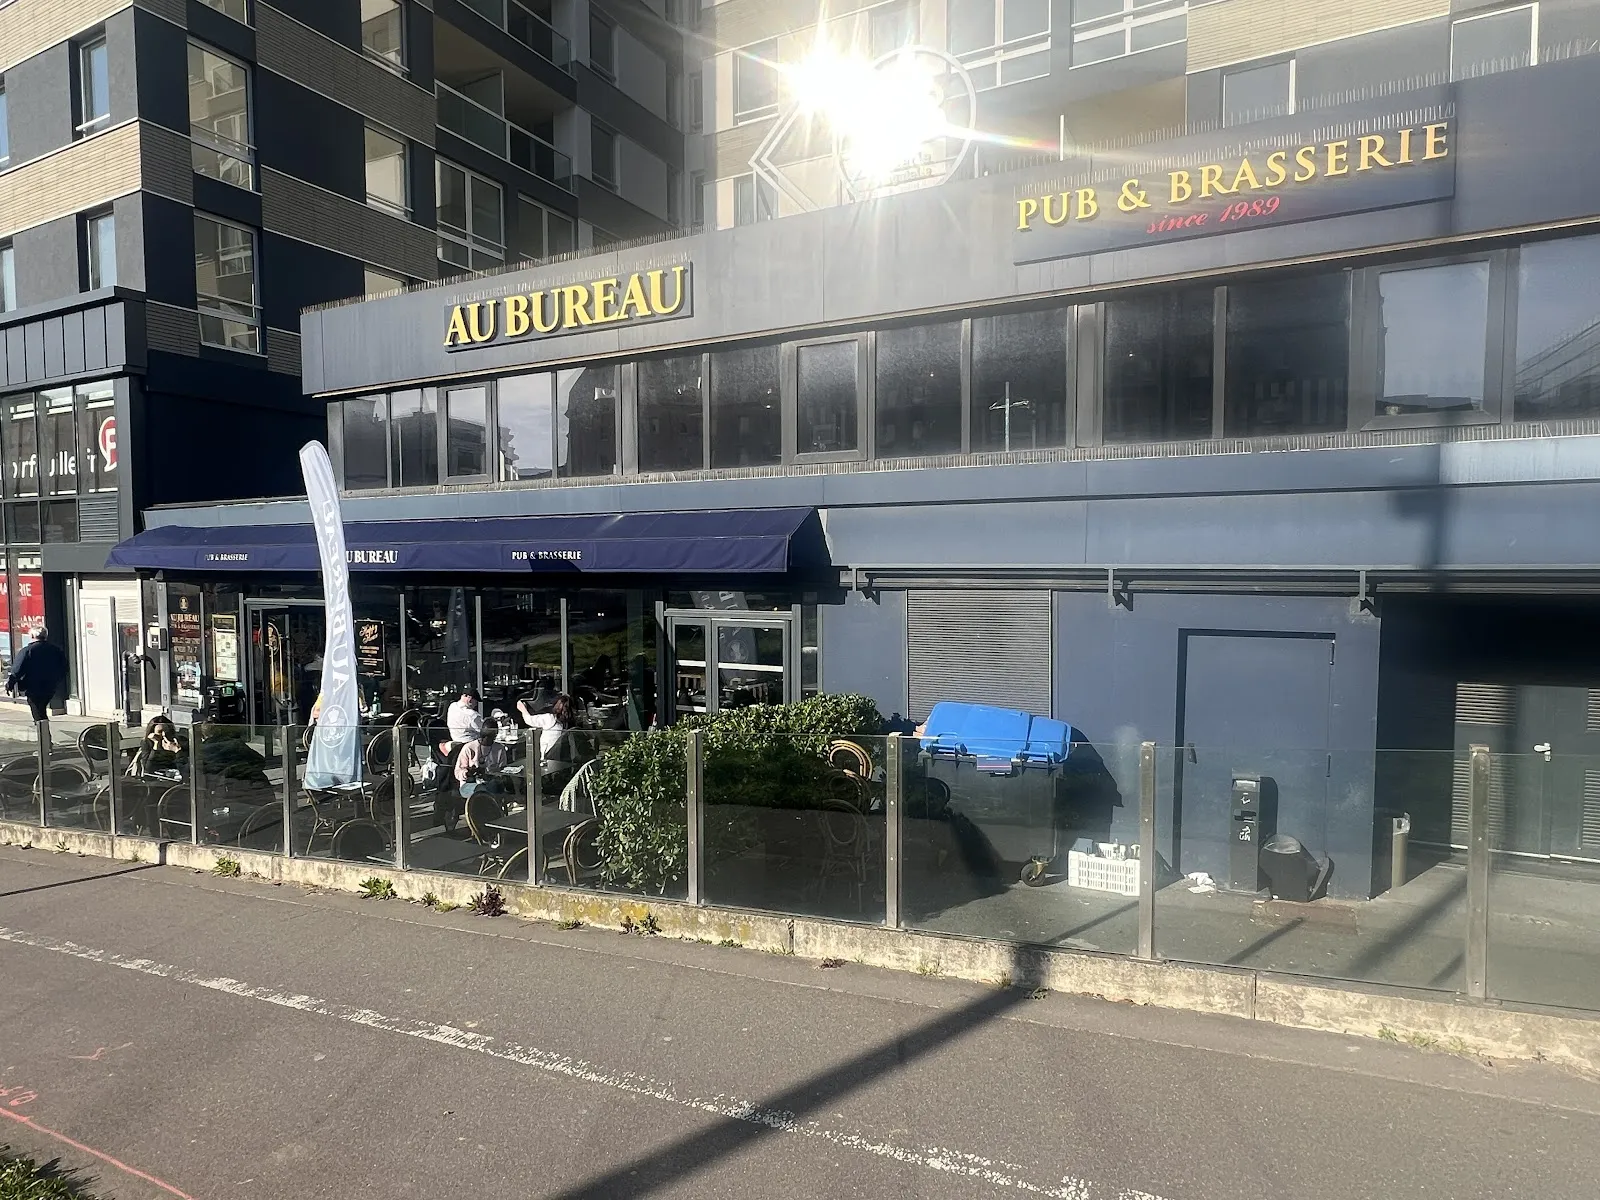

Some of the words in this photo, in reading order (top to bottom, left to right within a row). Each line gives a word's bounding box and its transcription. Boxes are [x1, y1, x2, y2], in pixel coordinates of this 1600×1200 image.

[1016, 188, 1099, 230] PUB
[1117, 178, 1151, 211] &
[1167, 122, 1450, 204] BRASSERIE
[1146, 211, 1209, 234] since
[1219, 196, 1281, 224] 1989
[443, 299, 500, 346] AU
[503, 266, 685, 337] BUREAU
[354, 550, 399, 564] BUREAU
[511, 551, 527, 560] PUB
[529, 551, 536, 560] &
[538, 550, 582, 560] BRASSERIE
